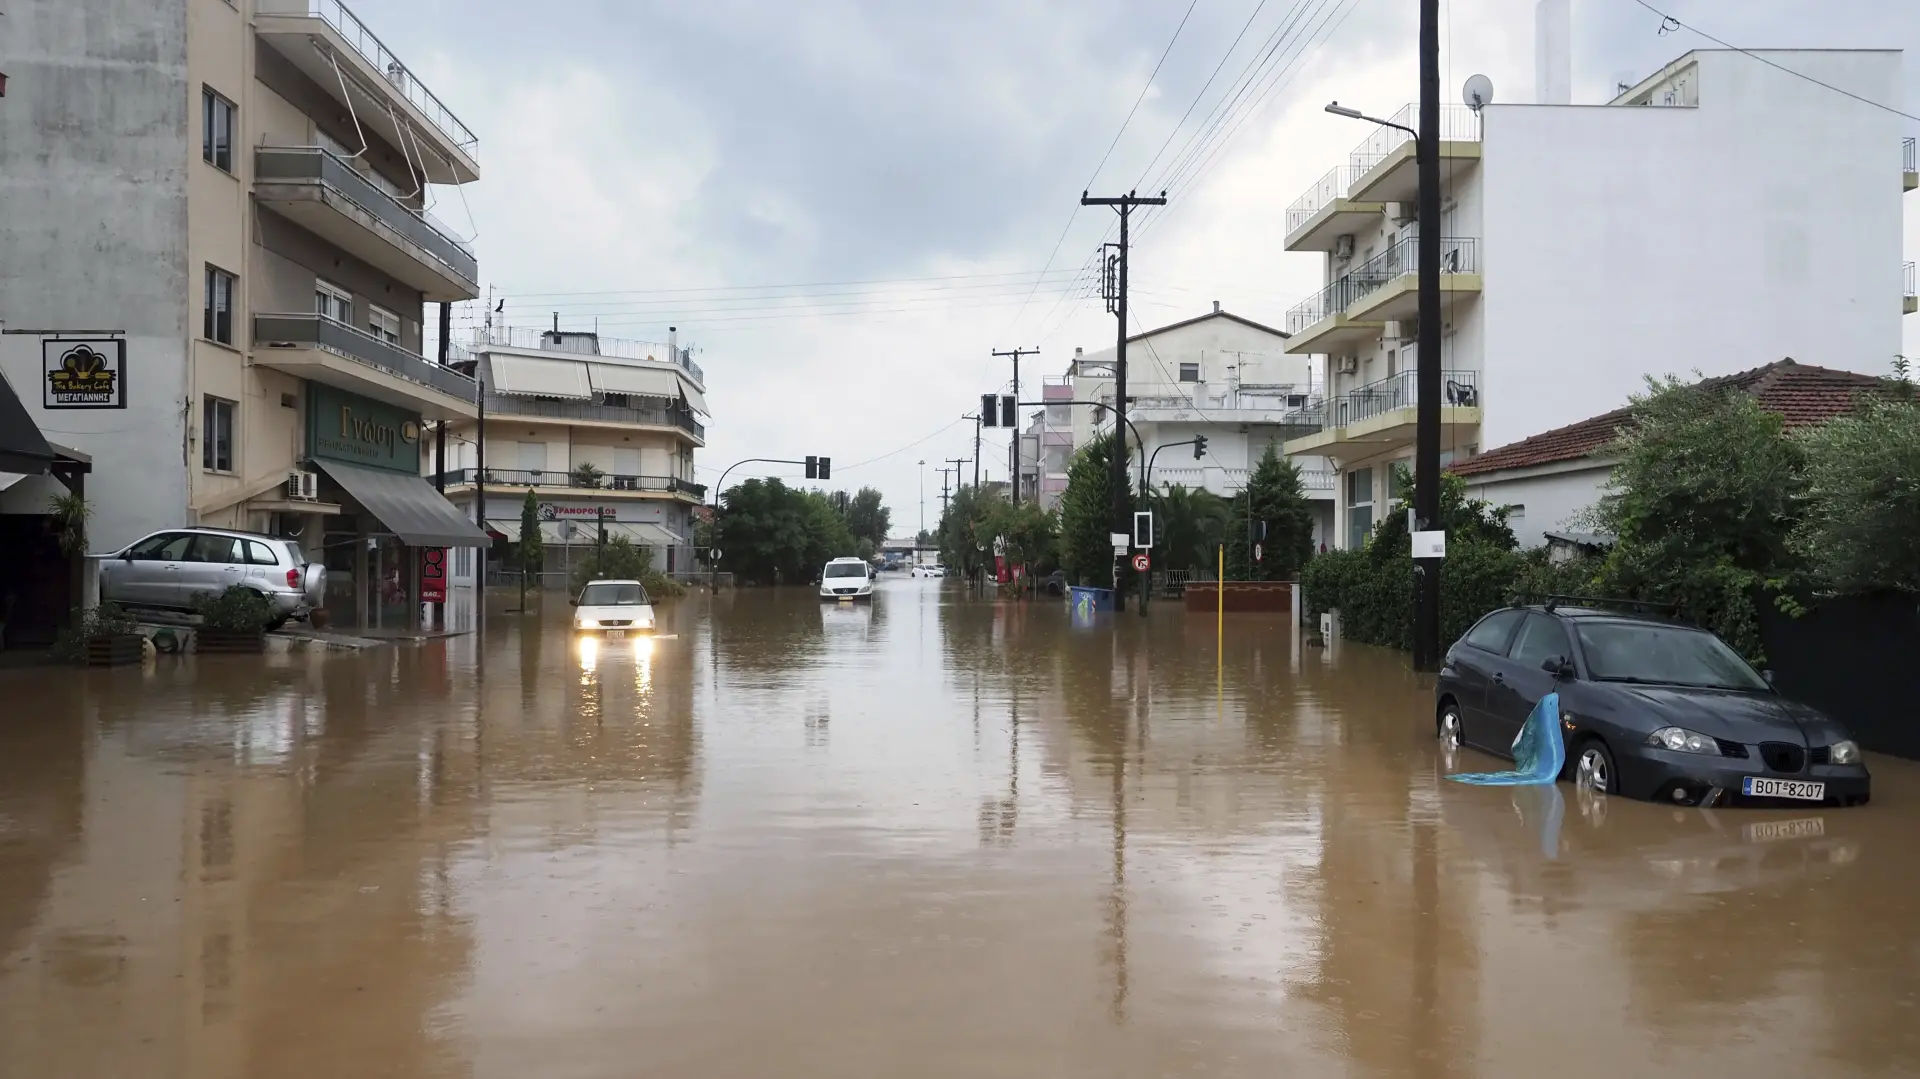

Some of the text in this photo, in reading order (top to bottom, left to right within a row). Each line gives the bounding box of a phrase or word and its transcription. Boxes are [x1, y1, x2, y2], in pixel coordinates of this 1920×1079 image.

[69, 381, 91, 391] Bakery
[58, 393, 109, 401] ΜΕΓΑΓΙΑΝΝΗΣ
[341, 405, 396, 459] Γνώση
